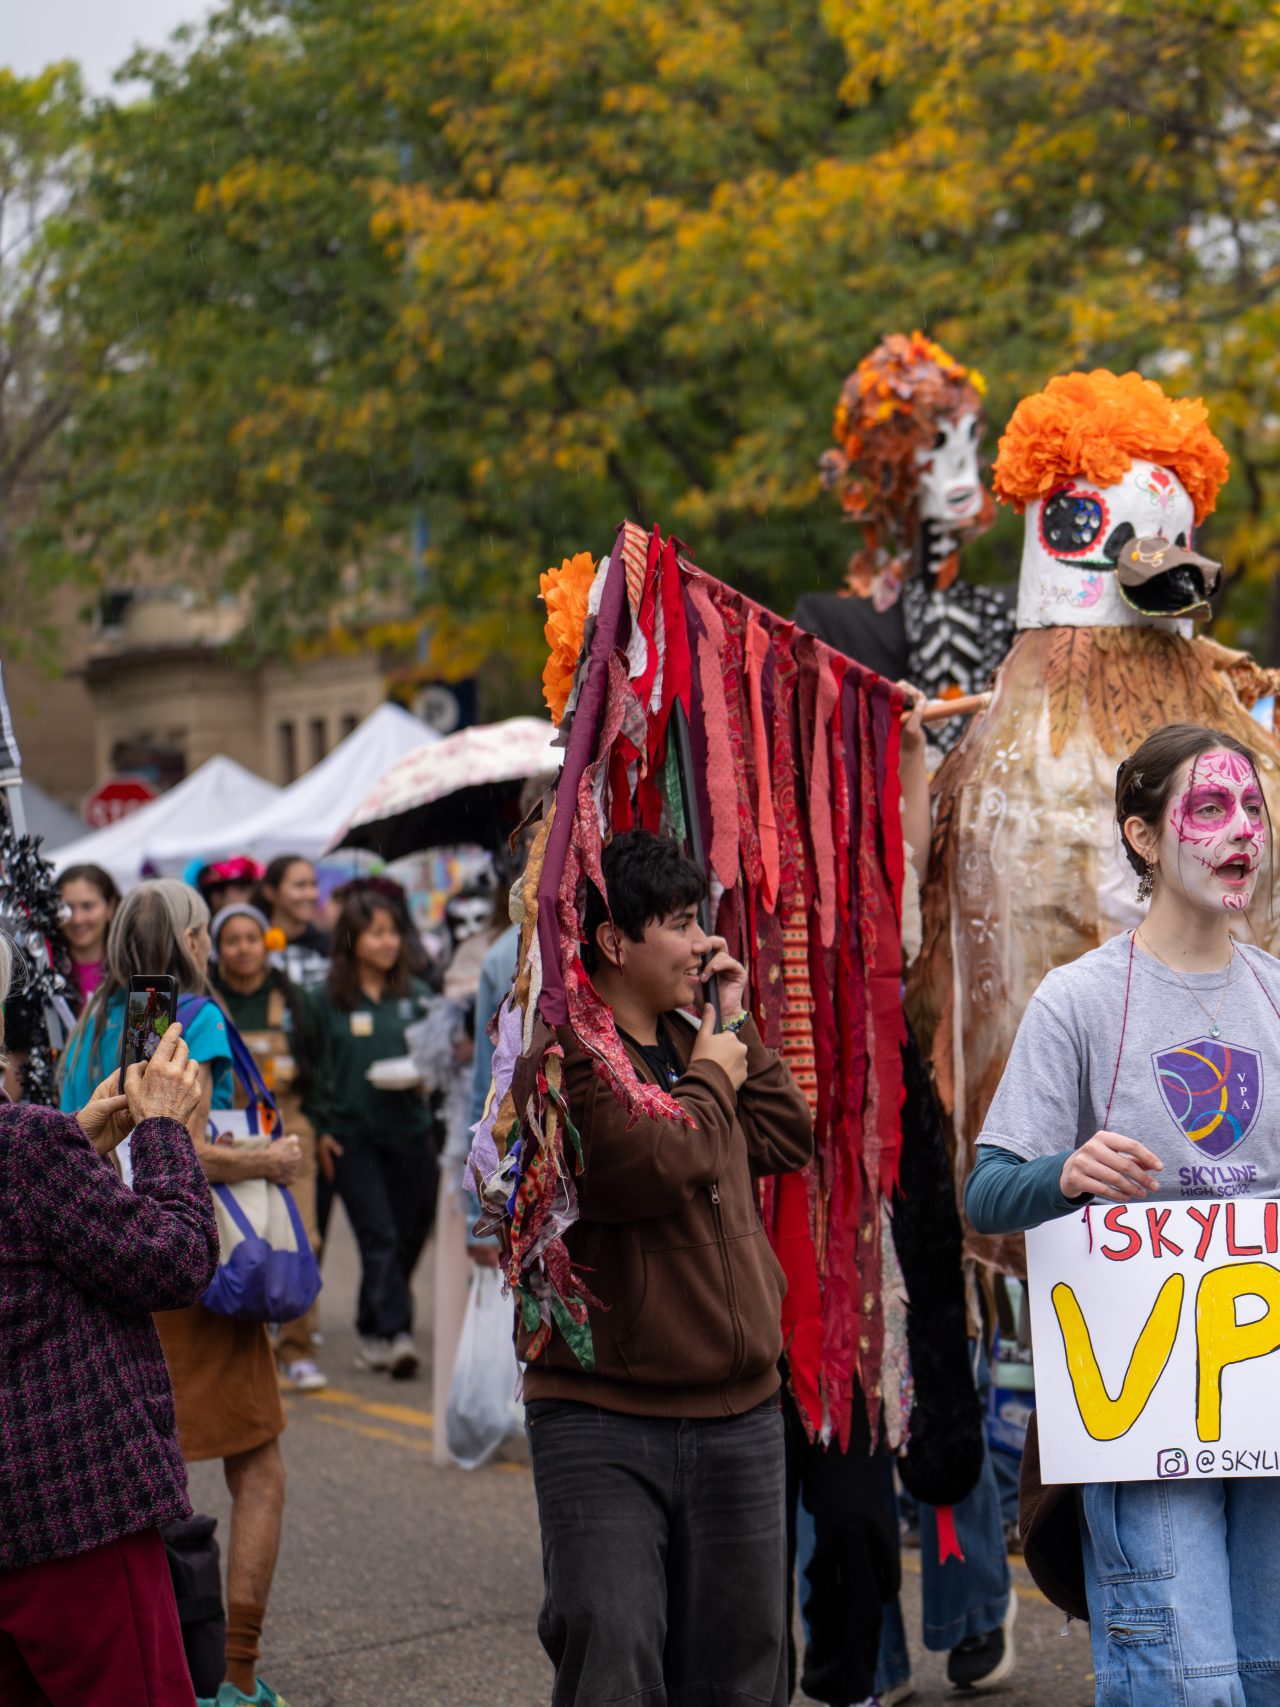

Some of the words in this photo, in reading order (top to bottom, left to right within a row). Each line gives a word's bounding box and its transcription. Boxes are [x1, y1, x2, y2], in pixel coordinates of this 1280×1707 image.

[1237, 1073, 1250, 1110] VPA
[1179, 1165, 1257, 1186] SKYLINE
[1181, 1187, 1214, 1197] HIGH
